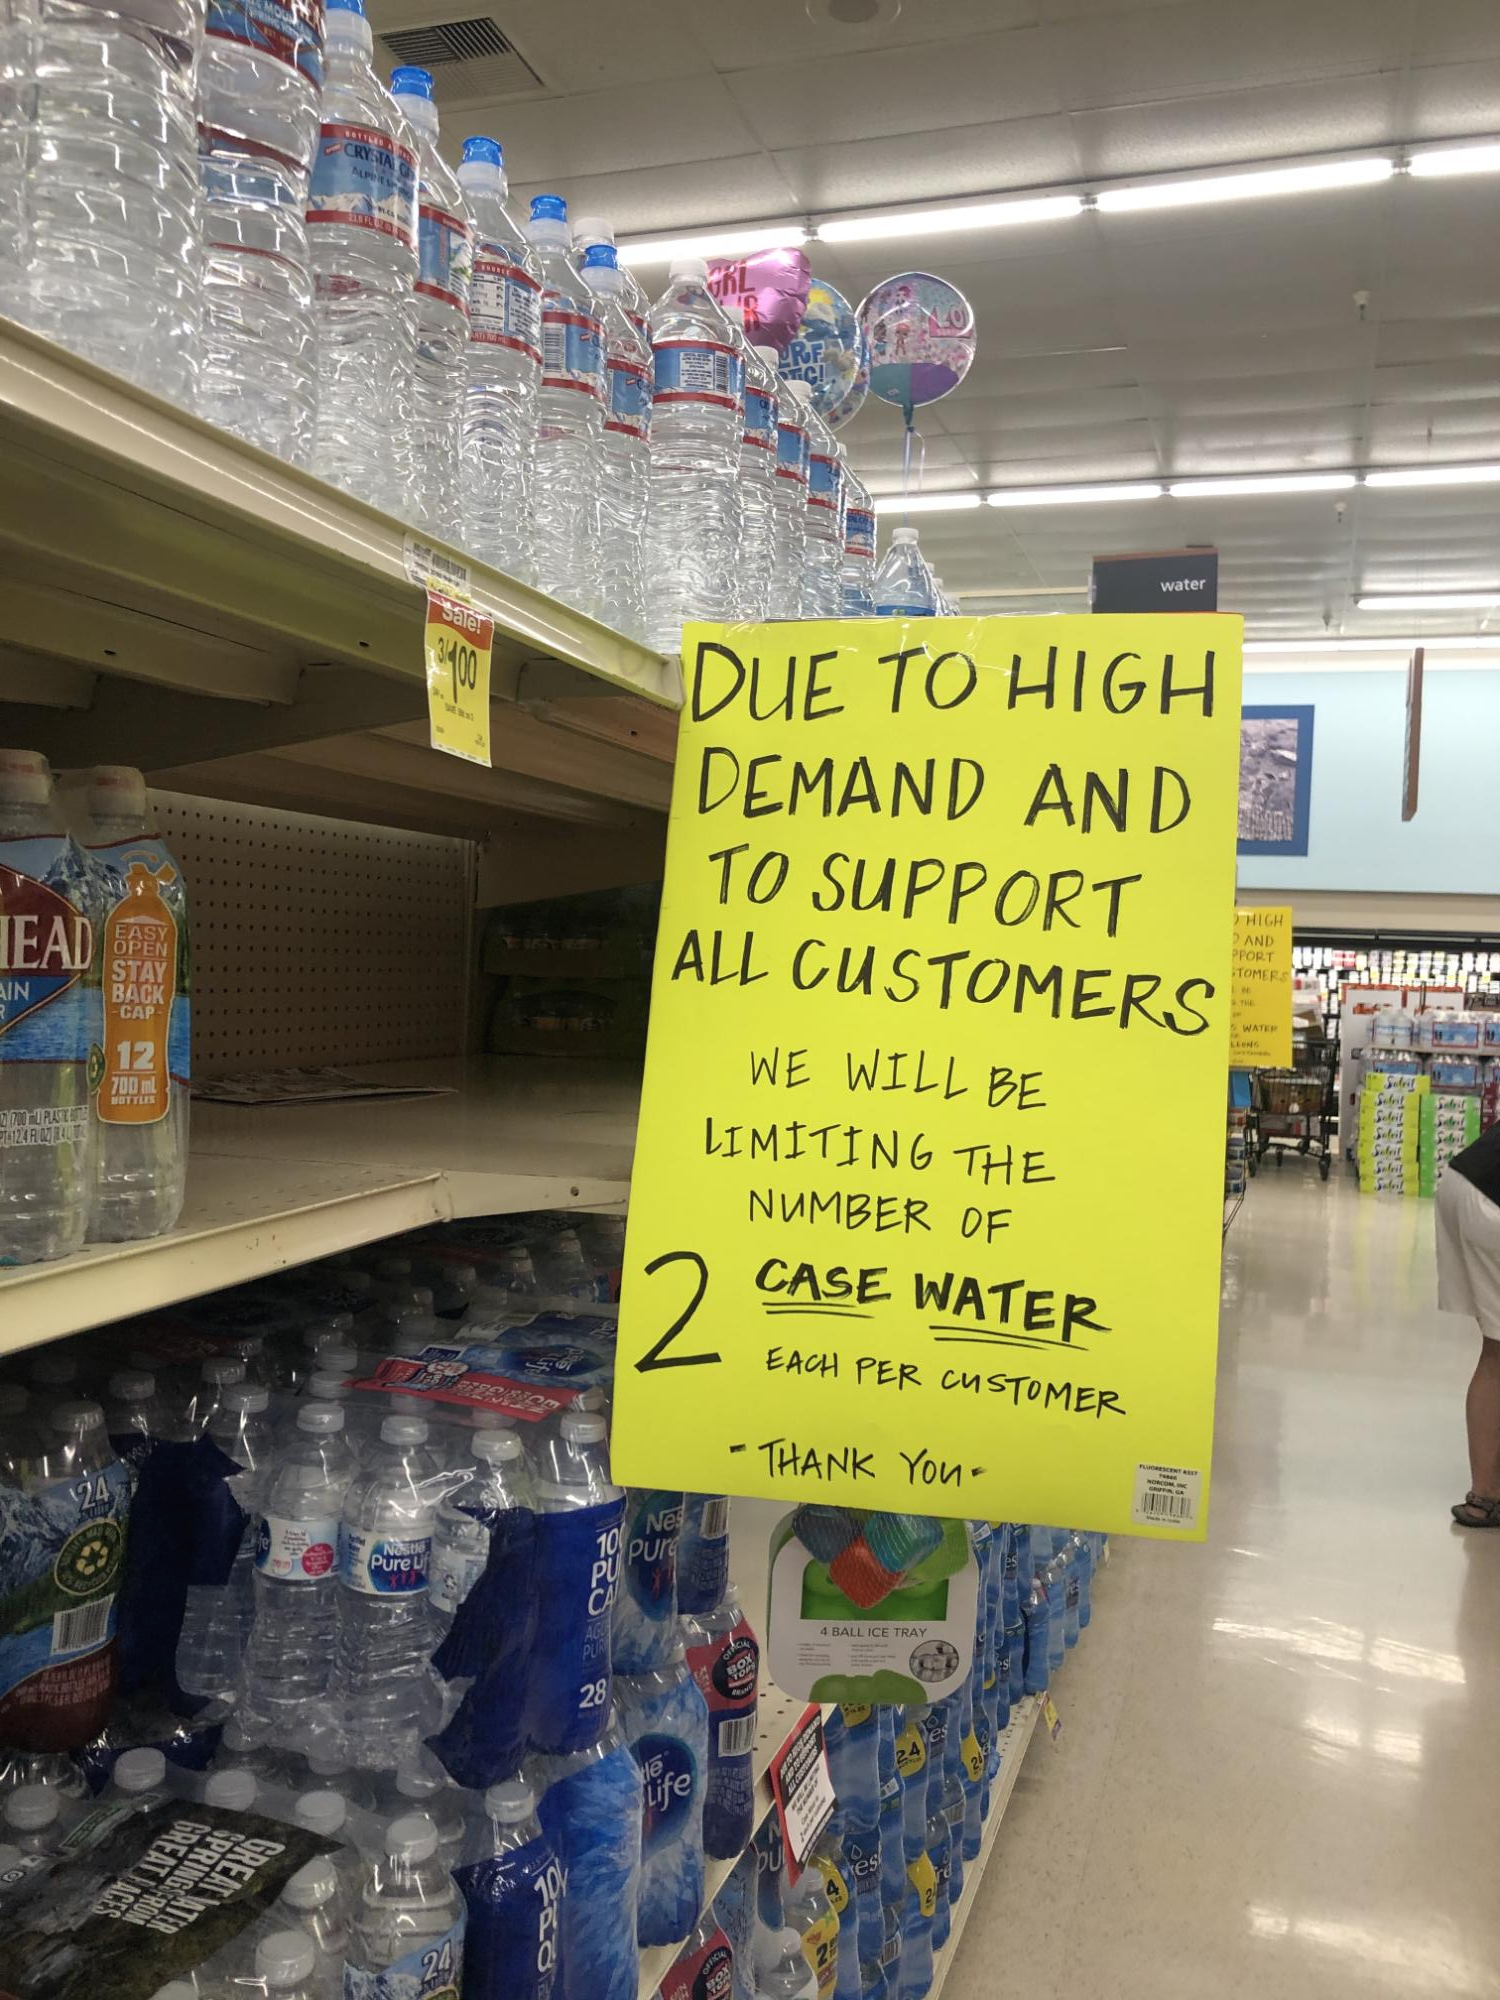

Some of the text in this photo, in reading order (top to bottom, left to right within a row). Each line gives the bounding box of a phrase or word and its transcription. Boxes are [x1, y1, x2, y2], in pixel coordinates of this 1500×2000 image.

[1160, 578, 1206, 592] water
[442, 606, 482, 634] Sale!
[692, 641, 1217, 724] DUE TO HIGH
[698, 746, 1191, 835] DEMAND AND
[708, 843, 1143, 938] TO SUPPORT
[115, 924, 168, 942] EASY
[1246, 914, 1284, 927] HIGH
[113, 940, 168, 957] OPEN
[1244, 934, 1274, 947] AND
[112, 959, 167, 983] STAY
[671, 930, 1216, 1036] ALL CUSTOMERS
[112, 983, 164, 1004] BACK
[1243, 1024, 1278, 1033] WATER
[117, 1040, 155, 1070] 12
[111, 1076, 138, 1096] 700
[749, 1047, 1047, 1110] WE WILL BE
[111, 1095, 156, 1105] BOTTLES
[705, 1117, 1057, 1185] LIMITING THE
[749, 1188, 1013, 1244] NUMBER OF
[633, 1250, 1113, 1373] 2 CASE WATER
[765, 1347, 1127, 1418] EACH PER CUSTOMER
[1139, 1464, 1181, 1473] FLUORESCENT
[77, 1476, 110, 1509] 24
[371, 1554, 411, 1572] Pure
[820, 1626, 928, 1638] 4 BALL ICE TRAY
[722, 1639, 752, 1661] OFFICIAL
[726, 1653, 753, 1675] BOX
[732, 1664, 757, 1682] TOPS
[579, 1678, 607, 1709] 28
[896, 1741, 921, 1765] 24
[646, 1771, 692, 1812] Life
[146, 1820, 212, 1878] GREAT
[199, 1837, 286, 1898] GREAT
[420, 1939, 452, 1982] 24
[706, 1963, 731, 1991] BOX
